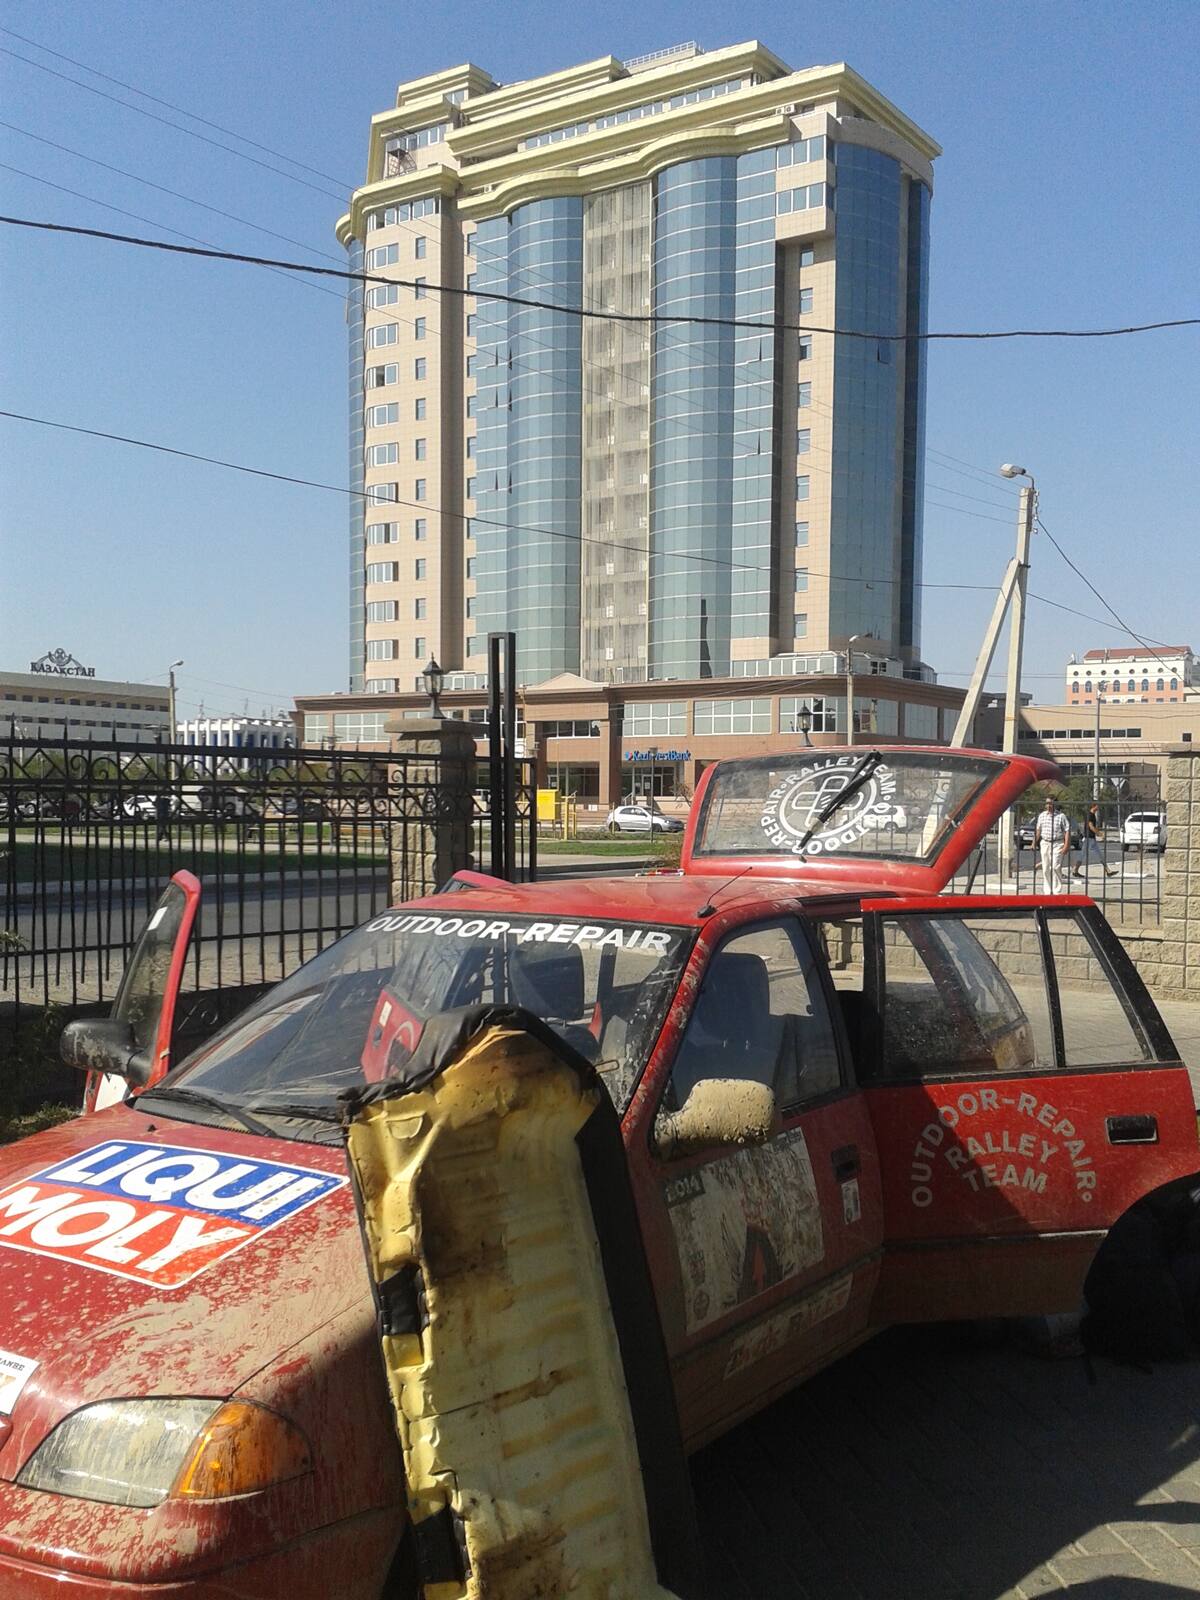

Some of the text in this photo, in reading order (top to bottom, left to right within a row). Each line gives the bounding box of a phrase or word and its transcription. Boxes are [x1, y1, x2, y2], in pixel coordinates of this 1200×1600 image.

[870, 762, 896, 794] EAM
[366, 915, 672, 952] OUTDOOR-REPAIR
[943, 1131, 1059, 1170] RALLEY
[45, 1144, 326, 1220] LIQUI
[962, 1164, 1049, 1194] TEAM
[0, 1185, 251, 1273] MOLY
